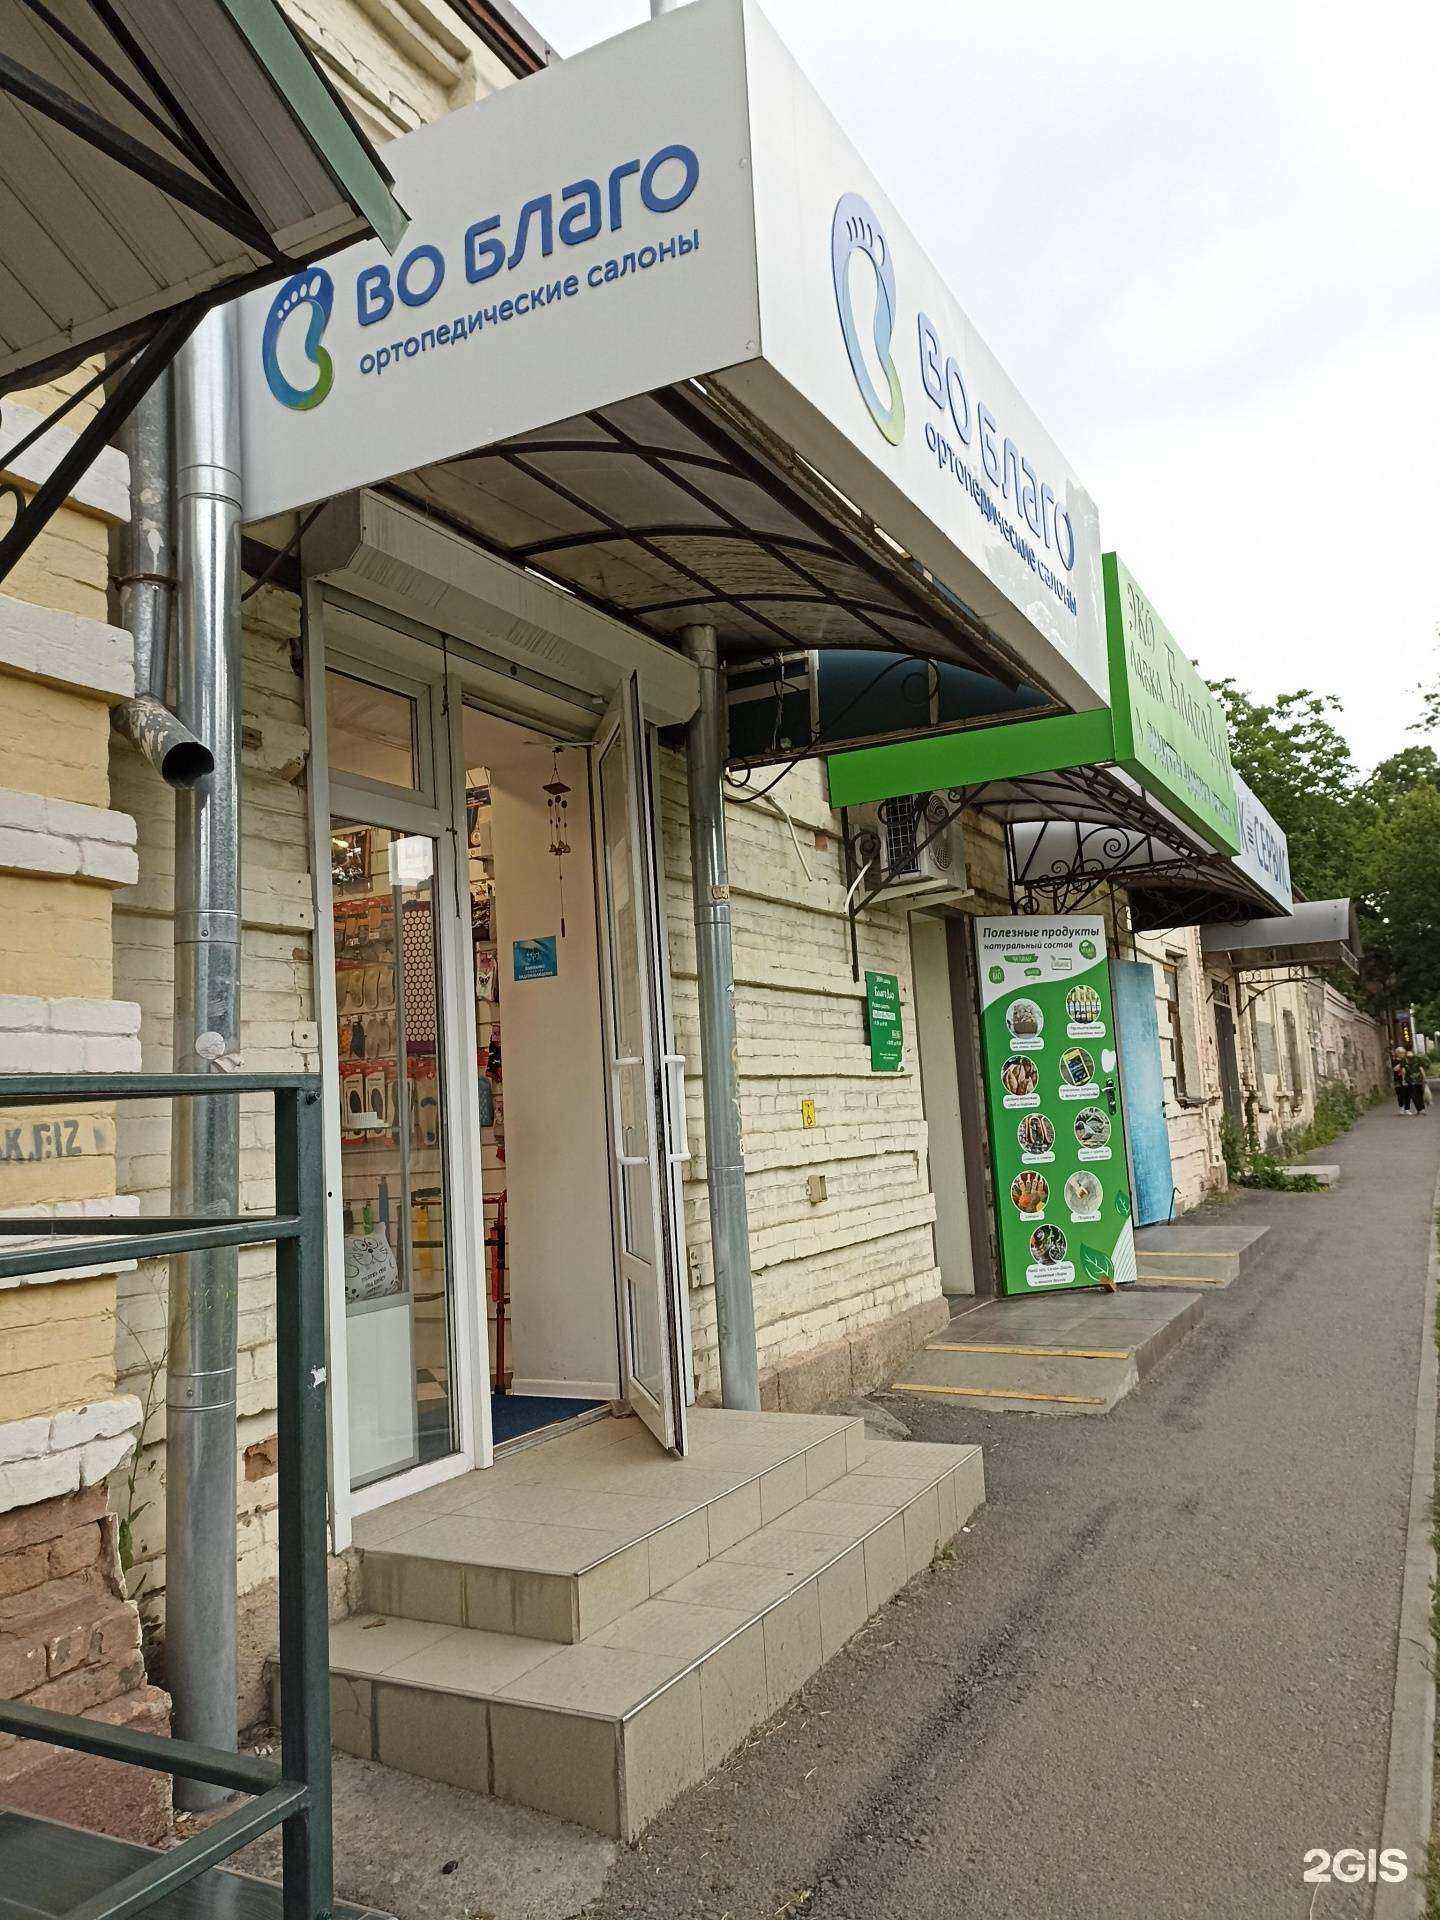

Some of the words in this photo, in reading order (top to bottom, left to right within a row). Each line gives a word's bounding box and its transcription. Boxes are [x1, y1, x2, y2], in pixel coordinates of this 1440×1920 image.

[356, 244, 446, 327] ВО
[359, 273, 579, 376] ортопедические
[587, 228, 700, 288] салоны
[917, 311, 972, 446] ВО
[983, 927, 1039, 938] Полезные
[1041, 926, 1099, 939] продукты
[984, 942, 1042, 951] натуральный
